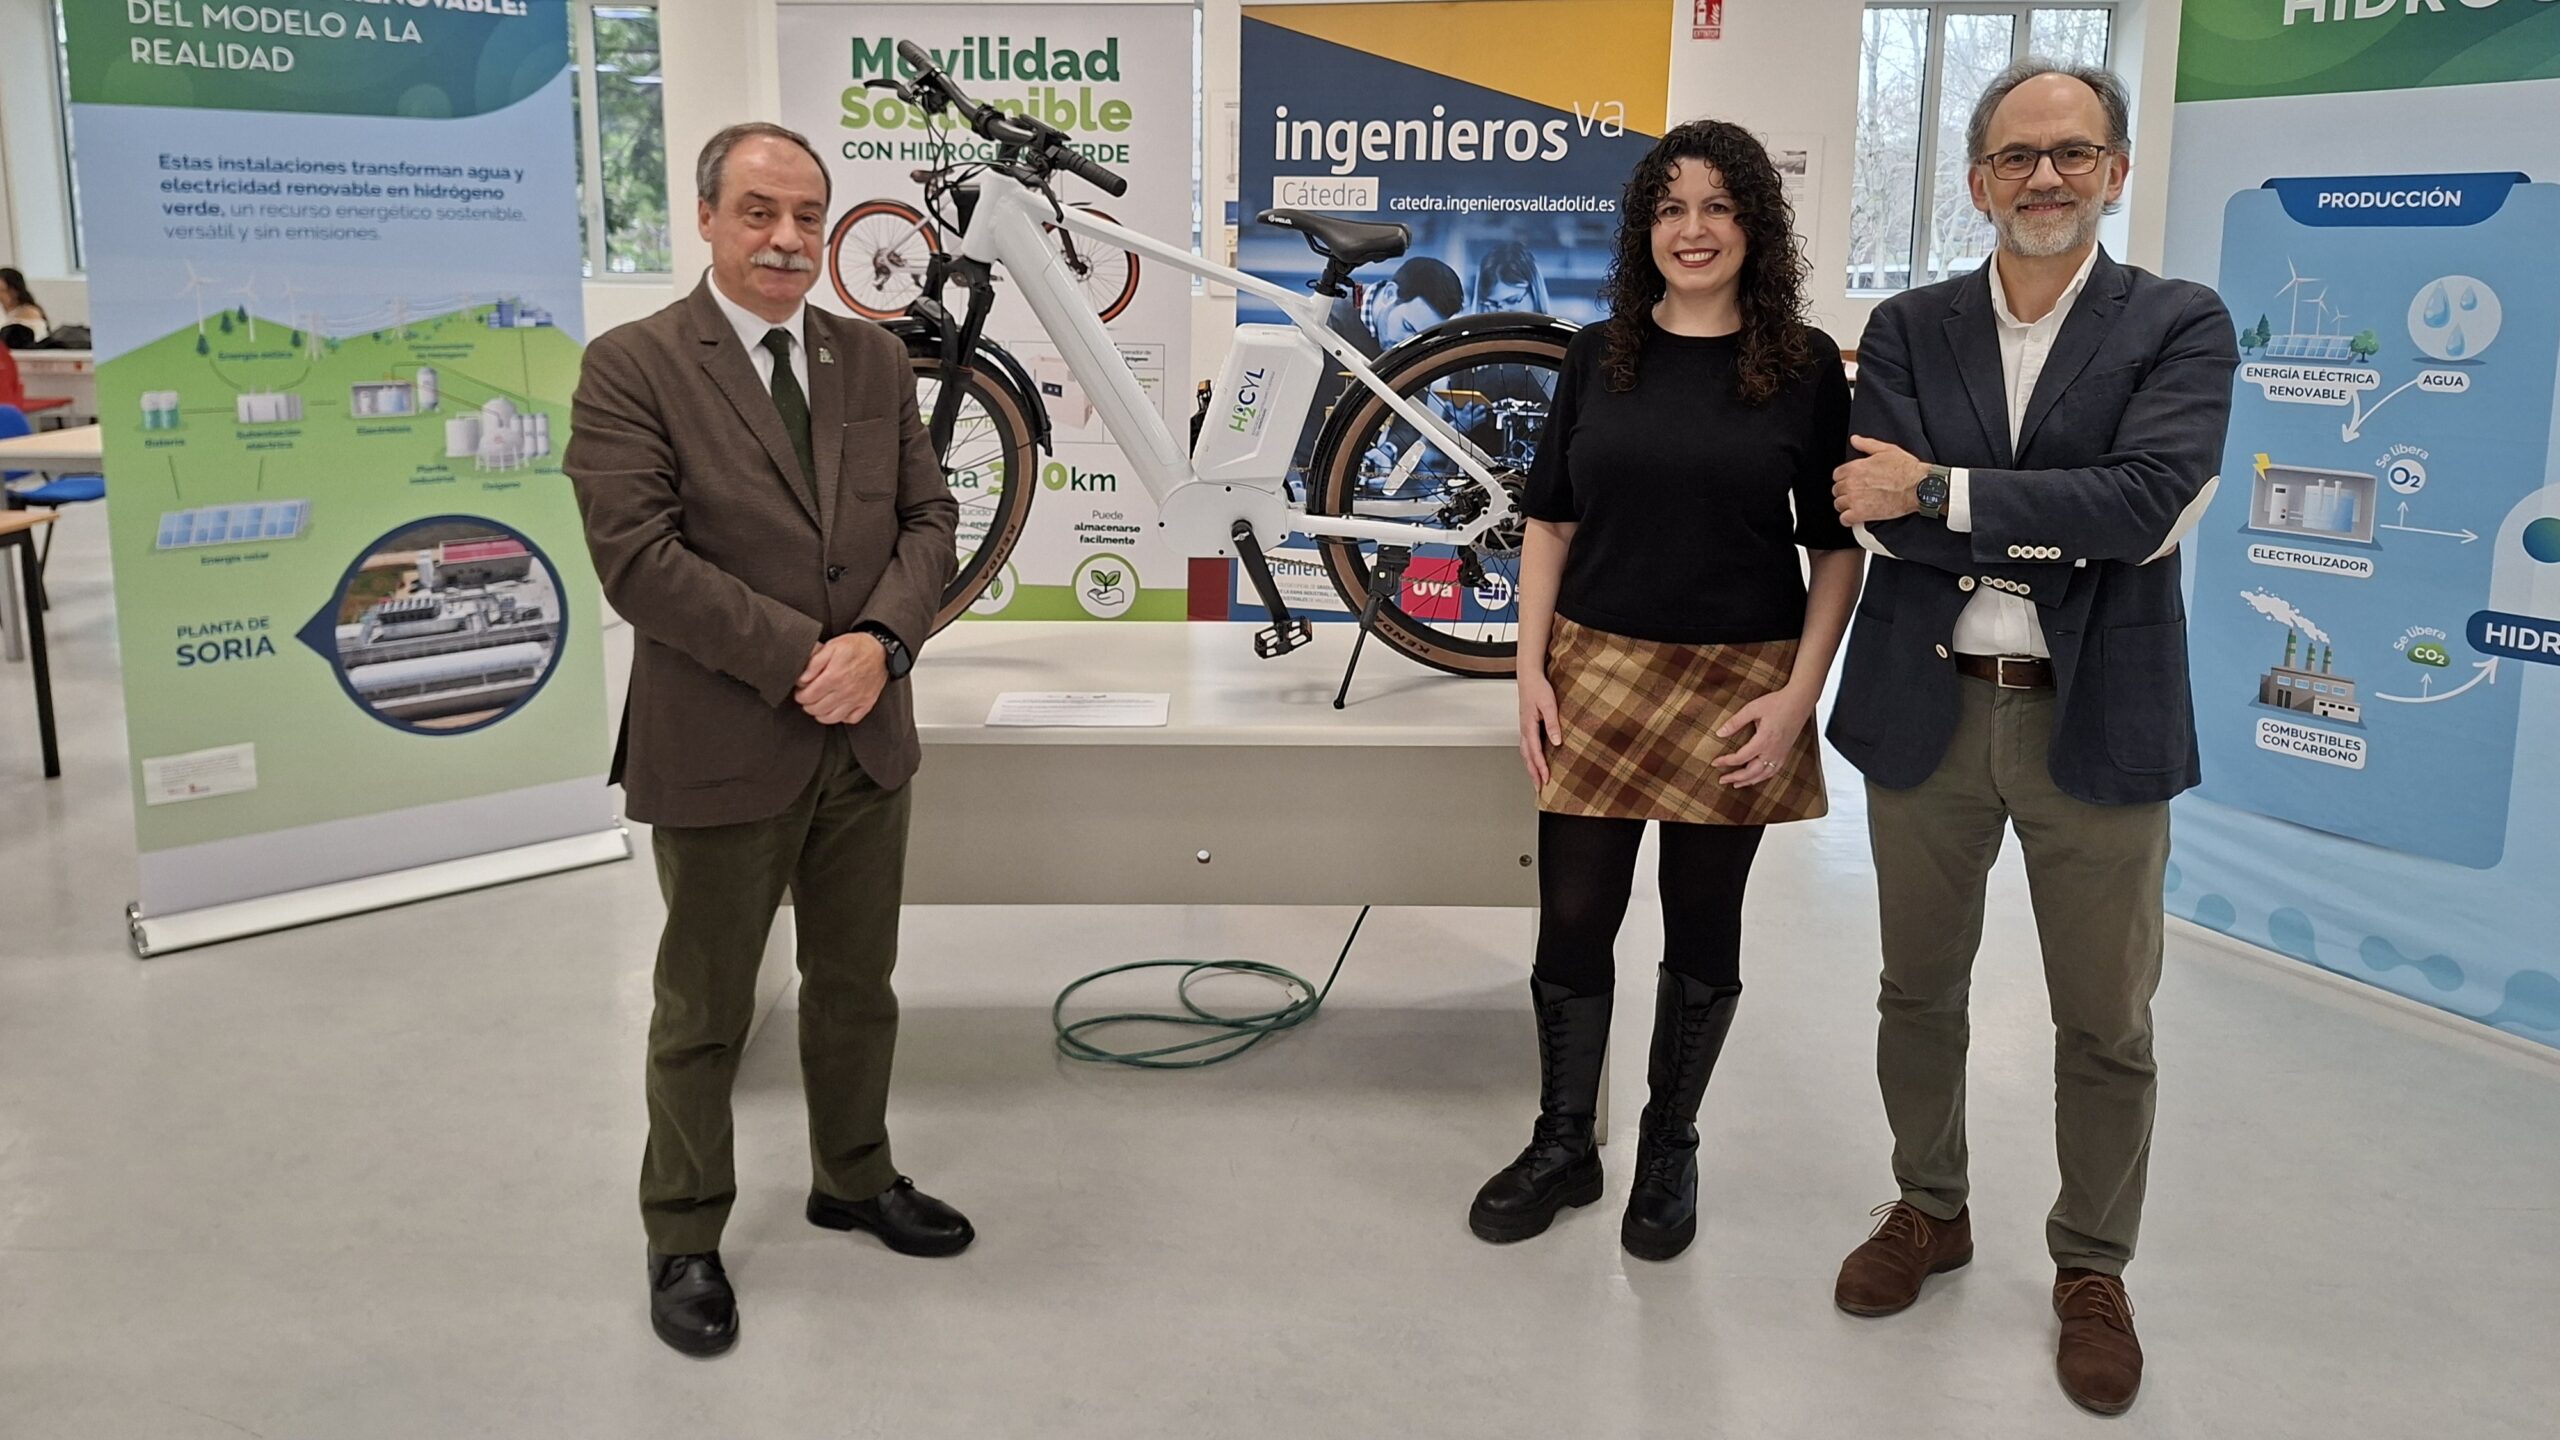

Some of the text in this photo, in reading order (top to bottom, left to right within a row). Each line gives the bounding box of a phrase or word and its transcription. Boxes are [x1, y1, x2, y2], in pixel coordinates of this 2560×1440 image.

[127, 0, 422, 44] DEL MODELO A LA
[130, 37, 294, 73] REALIDAD
[842, 137, 1130, 163] CON HIDRÓG ERDE
[1275, 104, 1569, 175] ingenieros
[159, 154, 524, 184] Estas instalaciones transforman agua y
[160, 176, 504, 203] electricidad renovable en hidrógeno
[1282, 181, 1367, 206] Cátedra
[2318, 186, 2462, 209] PRODUCCIÓN
[162, 200, 225, 217] verde,
[230, 203, 253, 217] un
[259, 204, 331, 219] recurso
[336, 203, 431, 223] energético
[1389, 194, 1616, 215] catedra.ingenierosvalladolid.es
[164, 222, 236, 240] versátil
[237, 226, 249, 243] y
[254, 225, 280, 240] sin
[2246, 366, 2375, 385] ENERGÍA ELÉCTRICA
[2422, 375, 2464, 387] AGUA
[2269, 385, 2347, 400] RENOVABLE
[2376, 443, 2430, 469] Se libera
[1074, 522, 1141, 533] almacenarse
[1092, 510, 1123, 520] Puede
[981, 524, 1017, 580] KENDA
[1079, 534, 1135, 545] facilmente
[2253, 547, 2368, 573] ELECTROLIZADOR
[177, 615, 270, 638] PLANTA DE
[2393, 625, 2447, 651] Se libera
[176, 635, 276, 667] SORIA
[2414, 646, 2446, 665] CO2
[2262, 722, 2361, 751] COMBUSTIBLES
[2262, 734, 2358, 763] CON CARBONO
